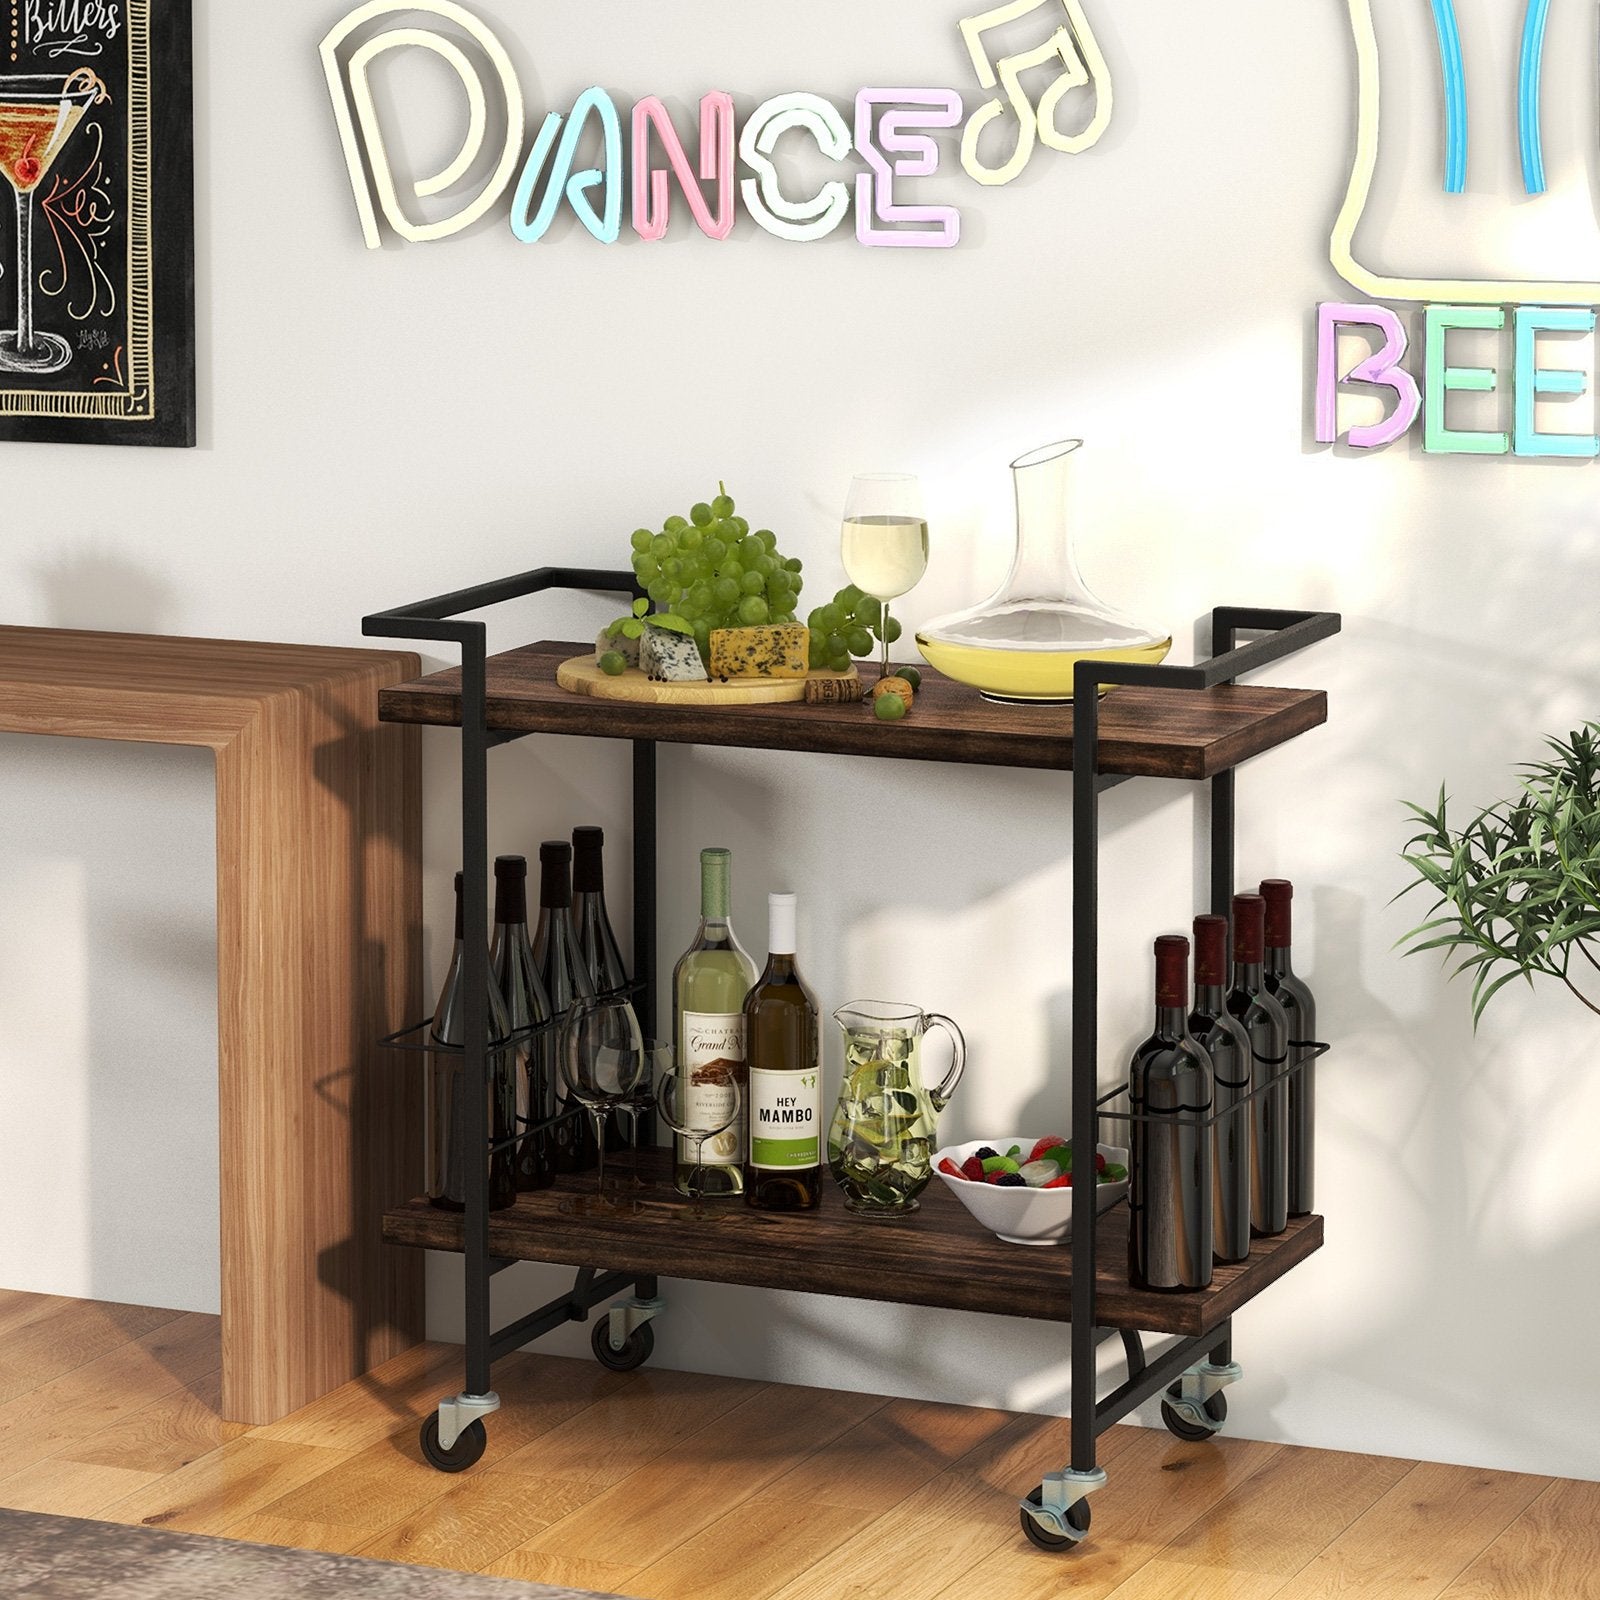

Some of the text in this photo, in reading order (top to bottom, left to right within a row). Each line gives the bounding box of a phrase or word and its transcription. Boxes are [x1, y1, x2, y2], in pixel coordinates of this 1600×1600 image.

[318, 0, 963, 249] DANCE
[1316, 301, 1600, 457] BEE
[691, 1035, 727, 1052] Grand
[777, 1097, 797, 1107] HEY
[759, 1108, 813, 1123] MAMBO
